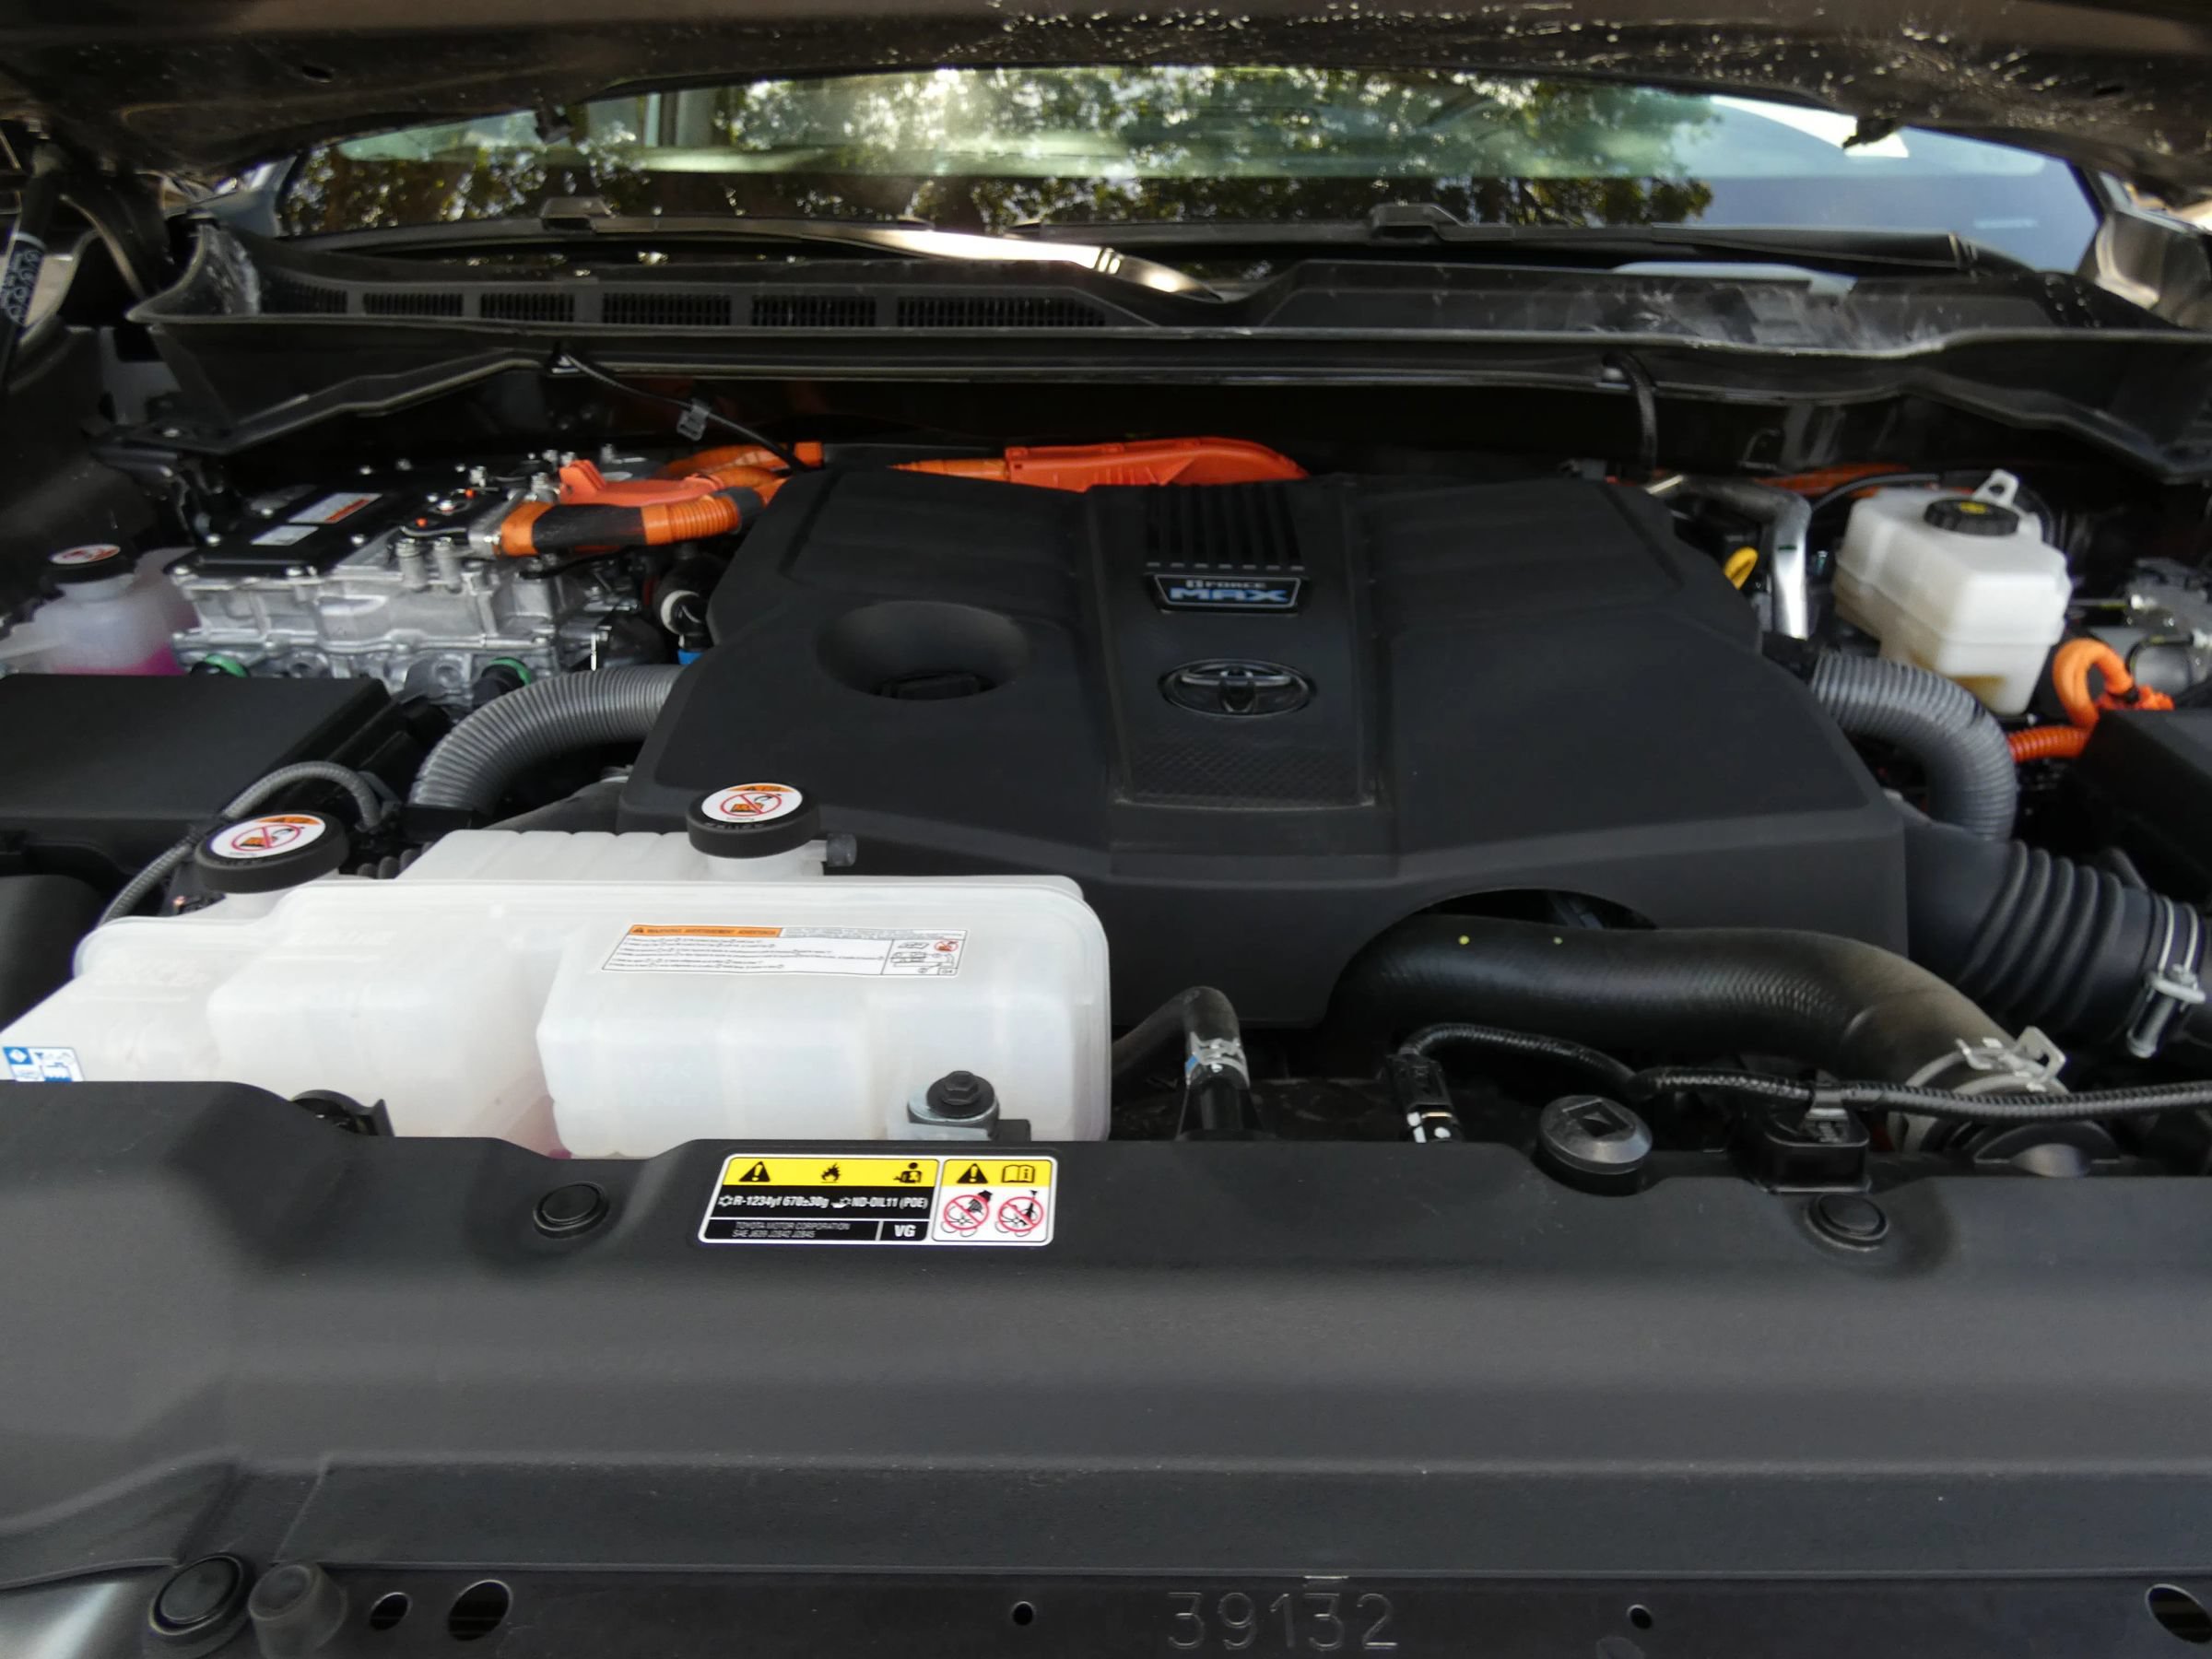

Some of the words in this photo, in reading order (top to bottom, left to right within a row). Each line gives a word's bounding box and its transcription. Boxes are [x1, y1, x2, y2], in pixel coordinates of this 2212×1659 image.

[1170, 587, 1288, 602] MAX
[733, 1195, 782, 1208] R-1234yf
[899, 1197, 928, 1210] (POE)
[894, 1224, 917, 1238] VG
[1167, 1592, 1399, 1651] 39132
